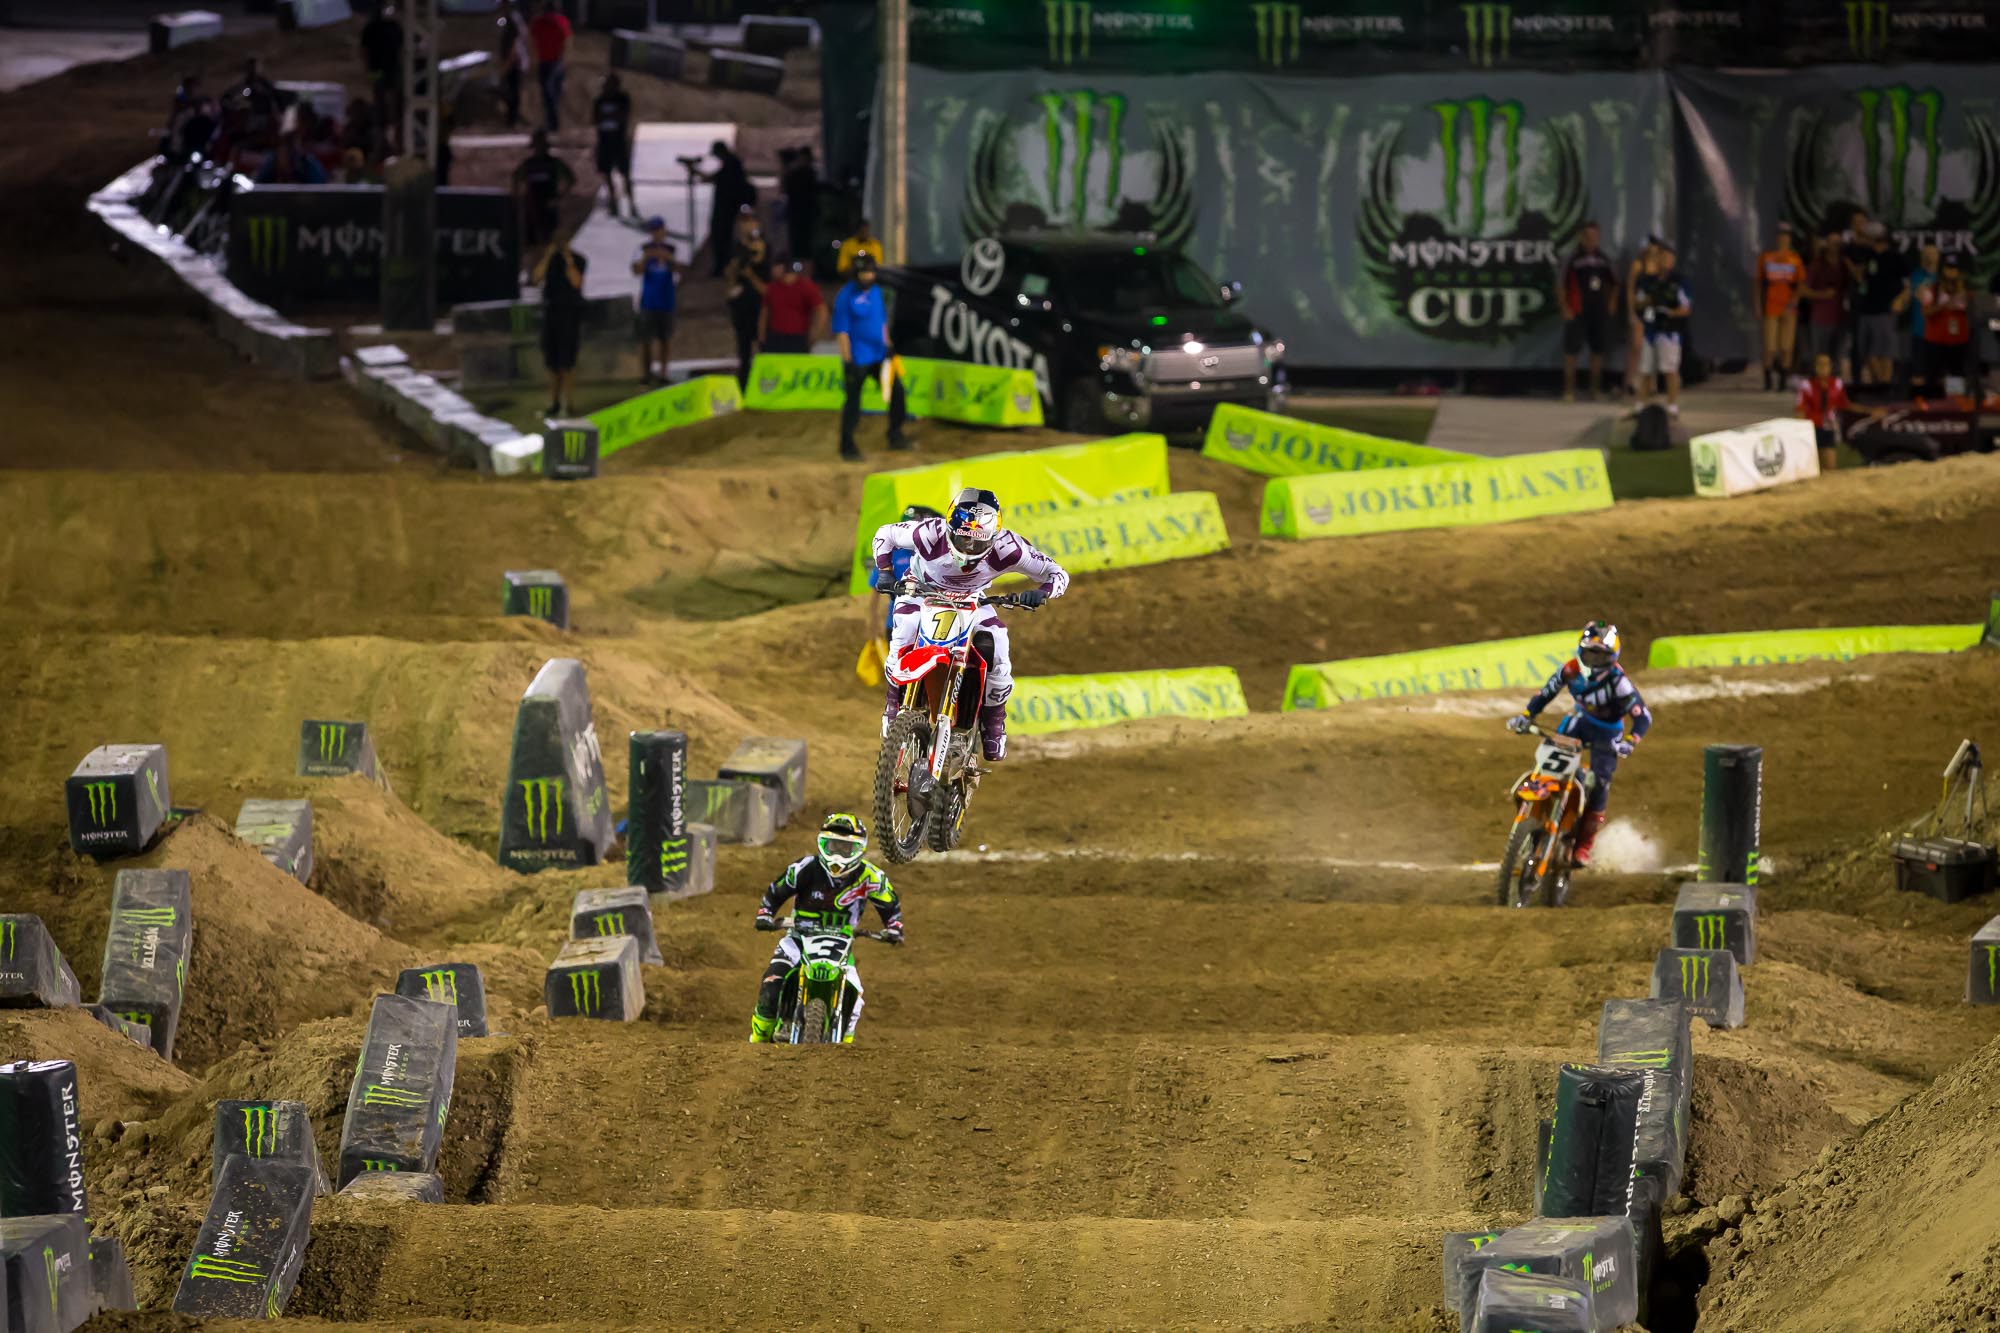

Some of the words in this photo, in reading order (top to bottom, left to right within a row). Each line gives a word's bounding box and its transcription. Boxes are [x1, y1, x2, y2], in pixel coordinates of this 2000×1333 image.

[1388, 235, 1558, 270] MONSTER
[1891, 229, 1978, 256] STER
[1407, 286, 1544, 327] CUP
[1339, 479, 1474, 517] JOKER
[1489, 464, 1601, 502] LANE
[1117, 506, 1217, 548] LANE
[932, 609, 958, 641] 1
[1010, 690, 1130, 725] JOKER
[1142, 682, 1238, 715] LANE
[1541, 750, 1576, 774] 5
[671, 748, 684, 836] MONSTER
[81, 829, 128, 841] MONSTER
[808, 936, 848, 961] 3
[381, 1043, 402, 1086] MONSTER
[1642, 1069, 1657, 1113] MONSTER
[62, 1081, 85, 1212] MONSTER
[1592, 1256, 1616, 1282] MONSTER
